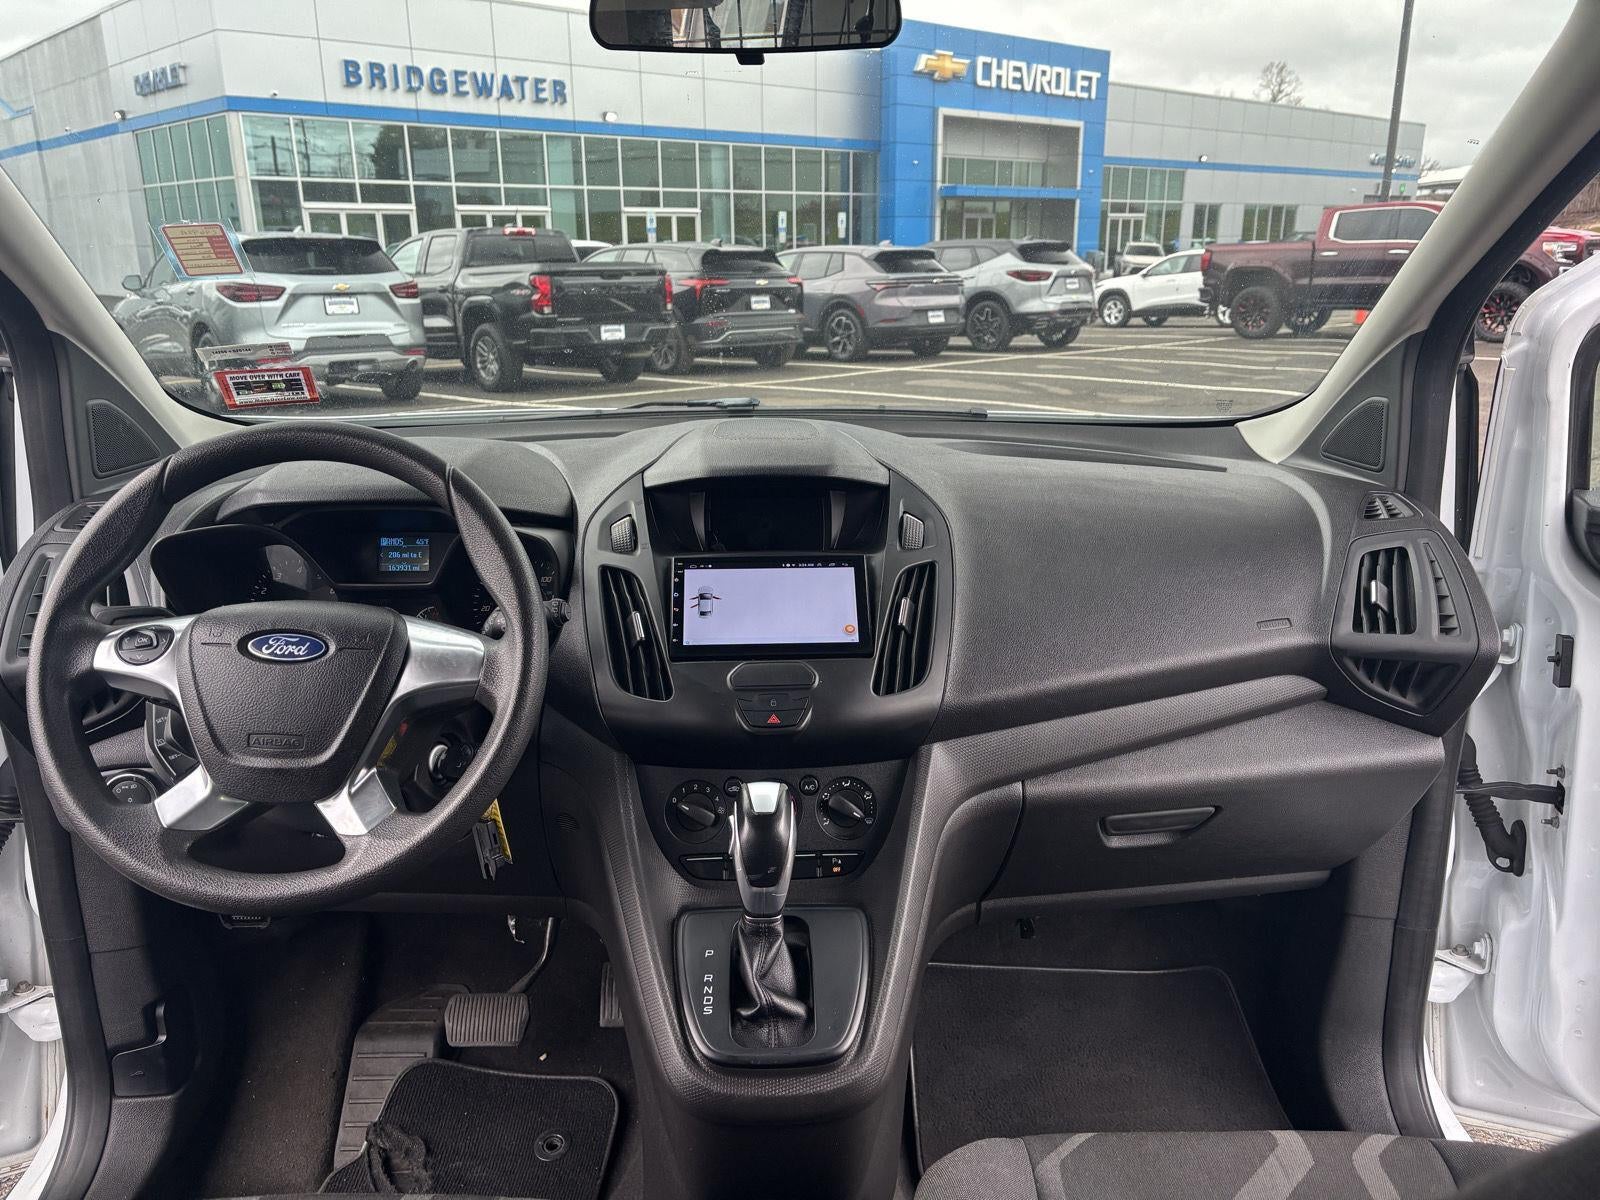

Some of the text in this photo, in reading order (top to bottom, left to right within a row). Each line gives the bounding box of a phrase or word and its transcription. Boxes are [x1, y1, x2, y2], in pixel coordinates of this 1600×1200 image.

[342, 58, 567, 105] BRIDGEWATER
[975, 56, 1099, 99] CHEVROLET
[229, 374, 248, 382] MOVE
[248, 373, 266, 381] OVER
[285, 371, 301, 379] CARE
[138, 636, 149, 644] OK
[261, 636, 310, 655] Ford
[250, 736, 300, 747] AIRBAG
[693, 783, 699, 791] 2
[704, 949, 714, 958] P
[703, 974, 713, 982] R
[703, 985, 713, 994] N
[702, 996, 713, 1005] D
[702, 1006, 713, 1015] S
